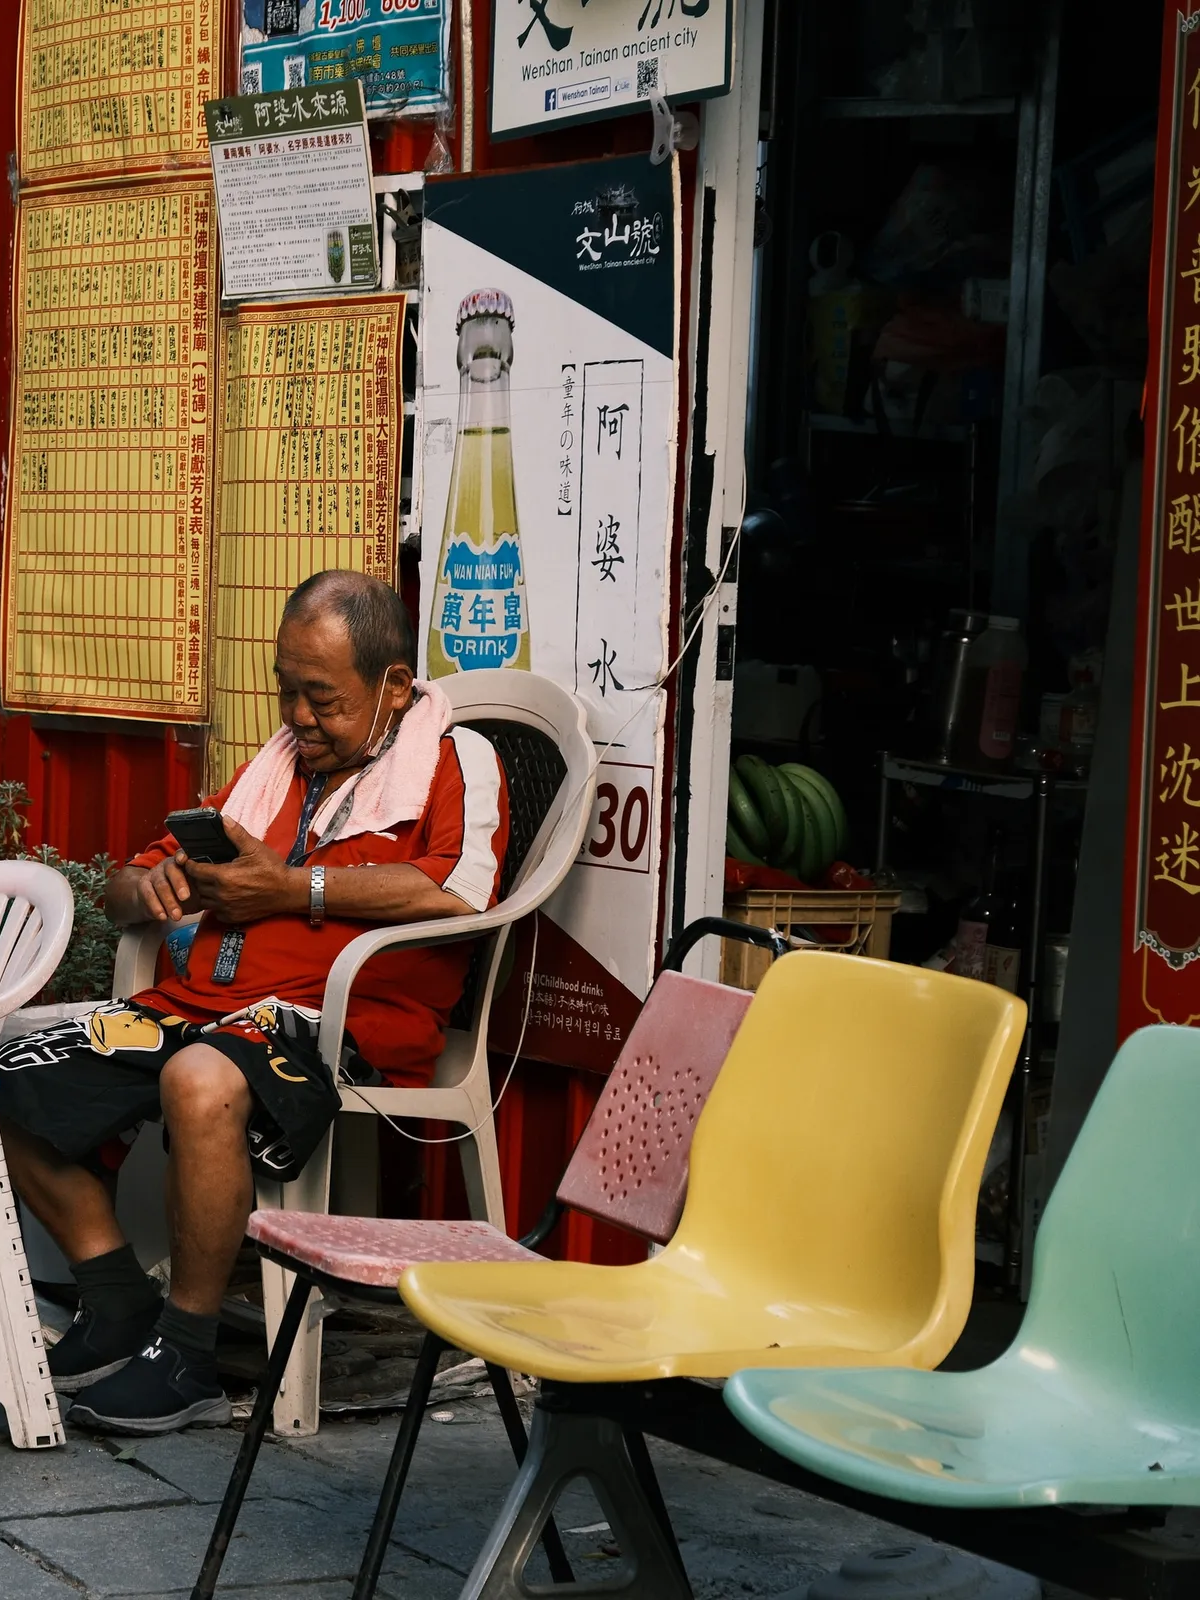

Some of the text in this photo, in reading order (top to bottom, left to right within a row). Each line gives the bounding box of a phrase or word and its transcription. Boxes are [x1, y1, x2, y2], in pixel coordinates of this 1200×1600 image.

[521, 57, 573, 82] WenShan
[622, 31, 670, 58] ancient
[674, 27, 698, 48] city
[254, 90, 349, 128] 阿婆水來源
[562, 85, 608, 101] Wenshan Tainan
[576, 213, 660, 261] 文山號
[623, 258, 644, 266] ancient
[588, 404, 629, 696] 阿婆水
[453, 563, 514, 581] WAN NIAN FUH
[441, 591, 521, 633] 萬年富
[589, 783, 649, 862] 30
[581, 982, 604, 997] drinks
